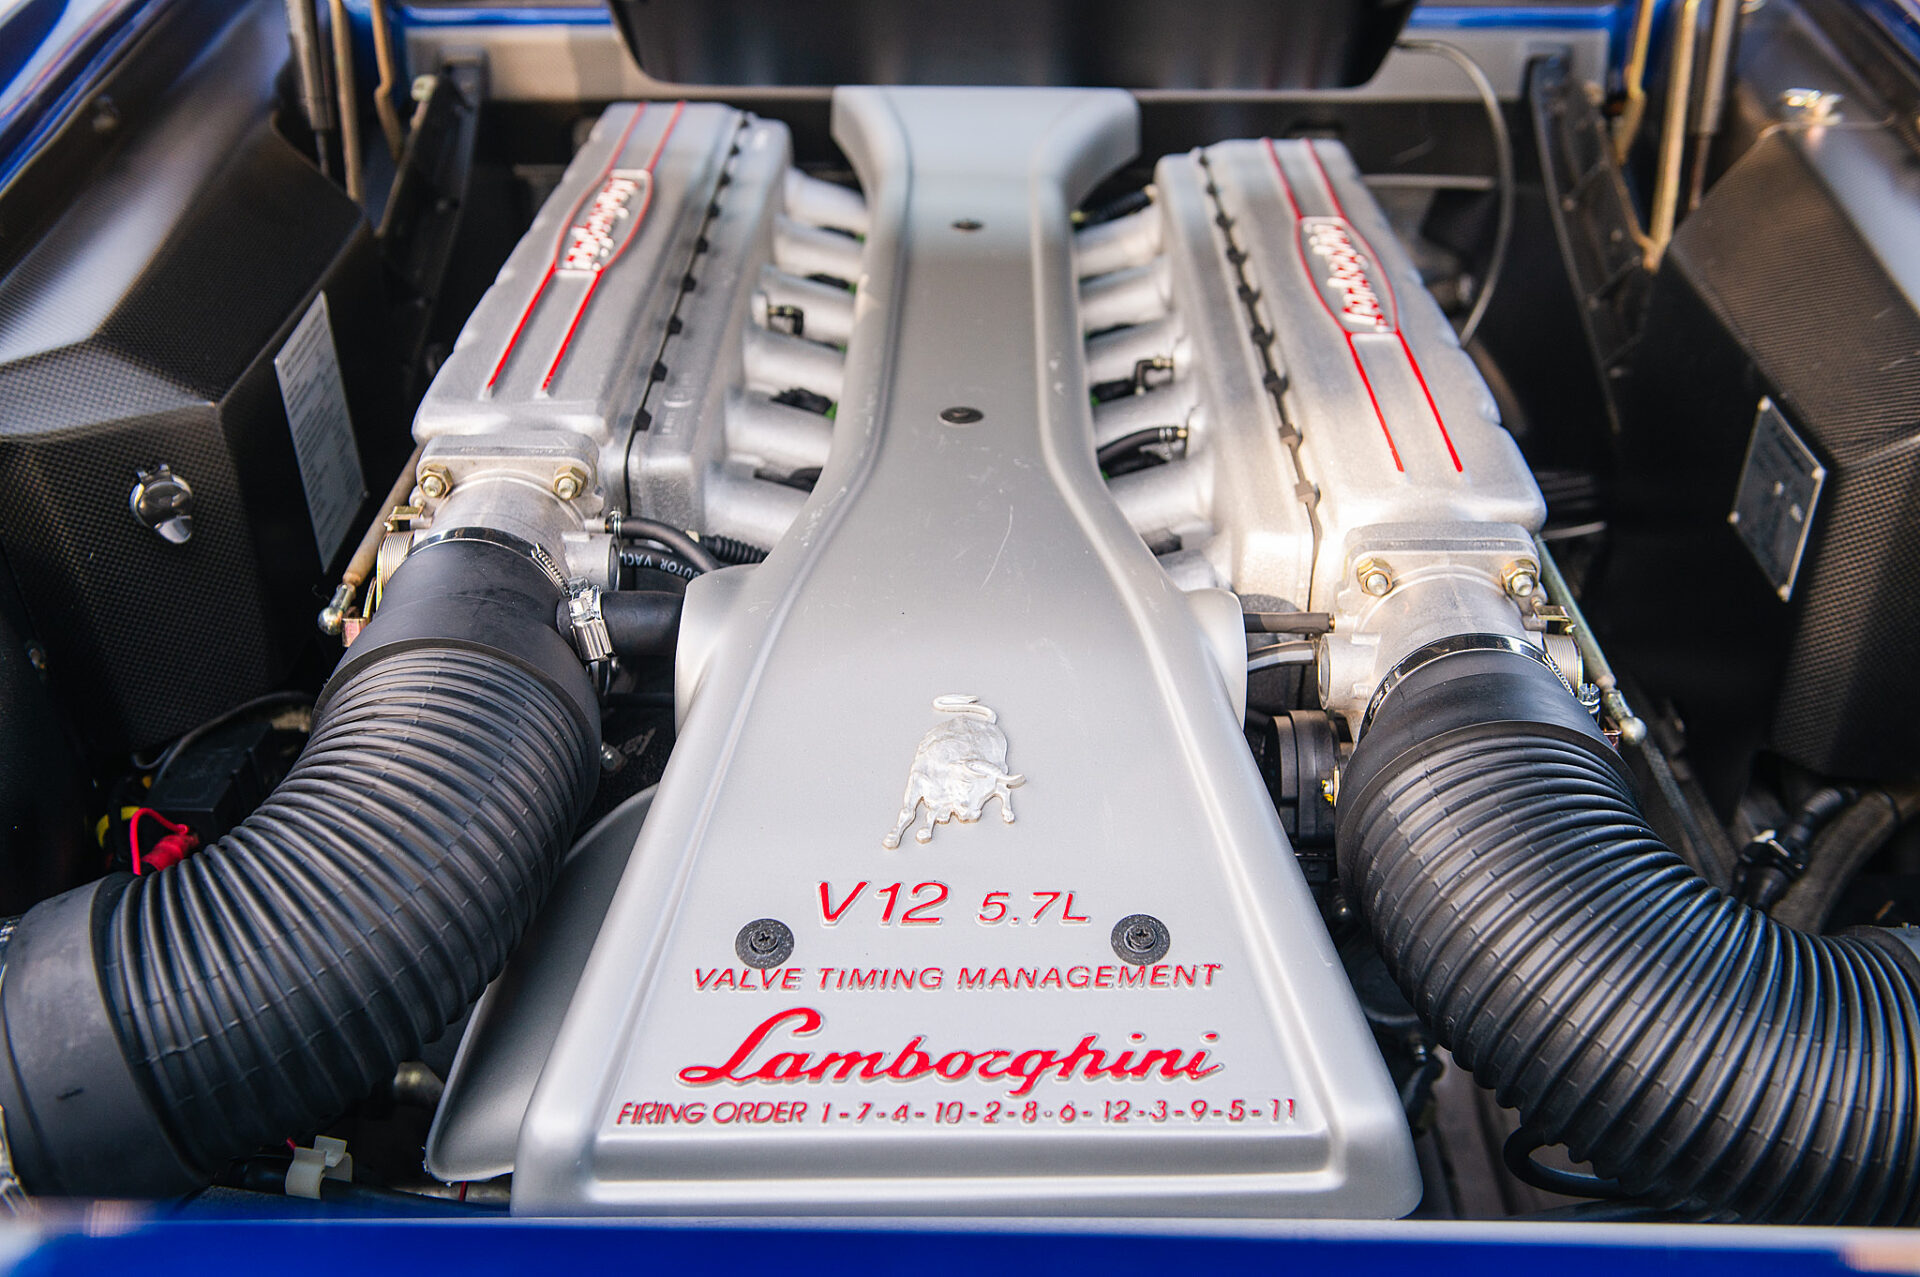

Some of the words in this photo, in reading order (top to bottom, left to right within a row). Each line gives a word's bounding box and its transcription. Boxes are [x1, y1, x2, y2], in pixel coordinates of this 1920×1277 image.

[817, 880, 949, 926] V12
[975, 890, 1091, 926] 5.7L
[693, 967, 804, 991] VALVE
[818, 967, 944, 991] TIMING
[956, 963, 1224, 991] MANAGEMENT
[675, 1006, 1224, 1099] Lamborghini
[615, 1101, 706, 1126] FIRING
[712, 1101, 808, 1125] ORDER
